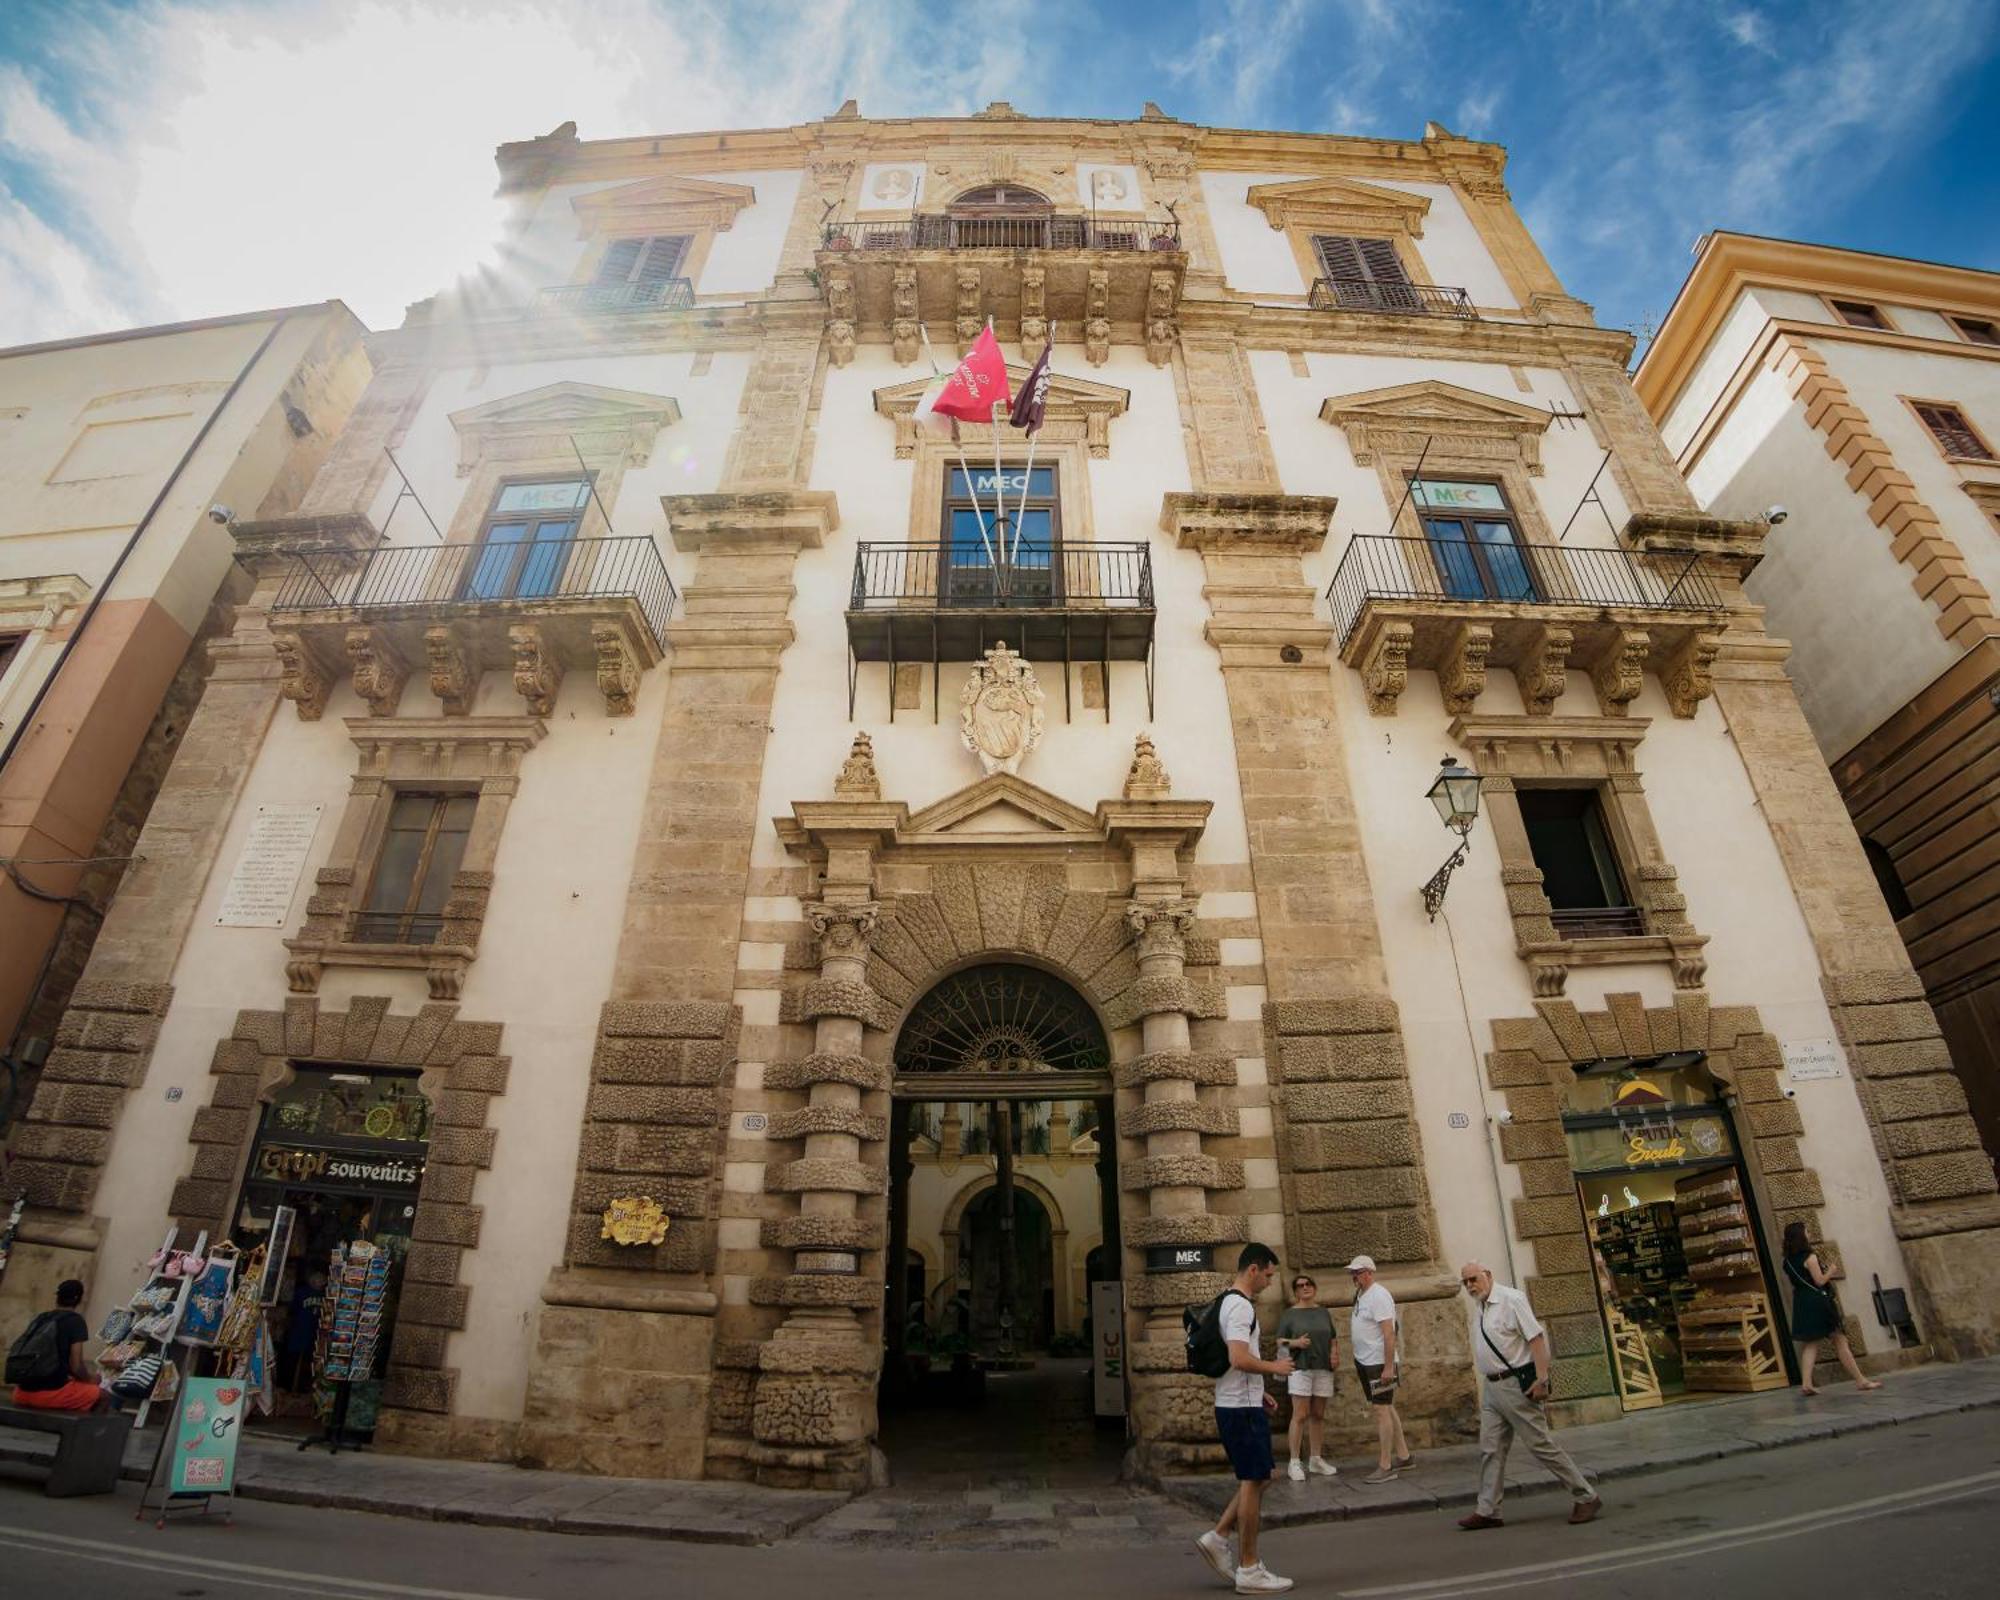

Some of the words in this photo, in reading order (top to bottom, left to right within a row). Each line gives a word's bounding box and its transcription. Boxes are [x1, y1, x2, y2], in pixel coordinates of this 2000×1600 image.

[977, 475, 1028, 489] MEC
[1434, 487, 1480, 502] MEC
[327, 1161, 417, 1184] souvenirs
[1176, 1250, 1201, 1262] MEC
[1104, 1332, 1121, 1378] MEC
